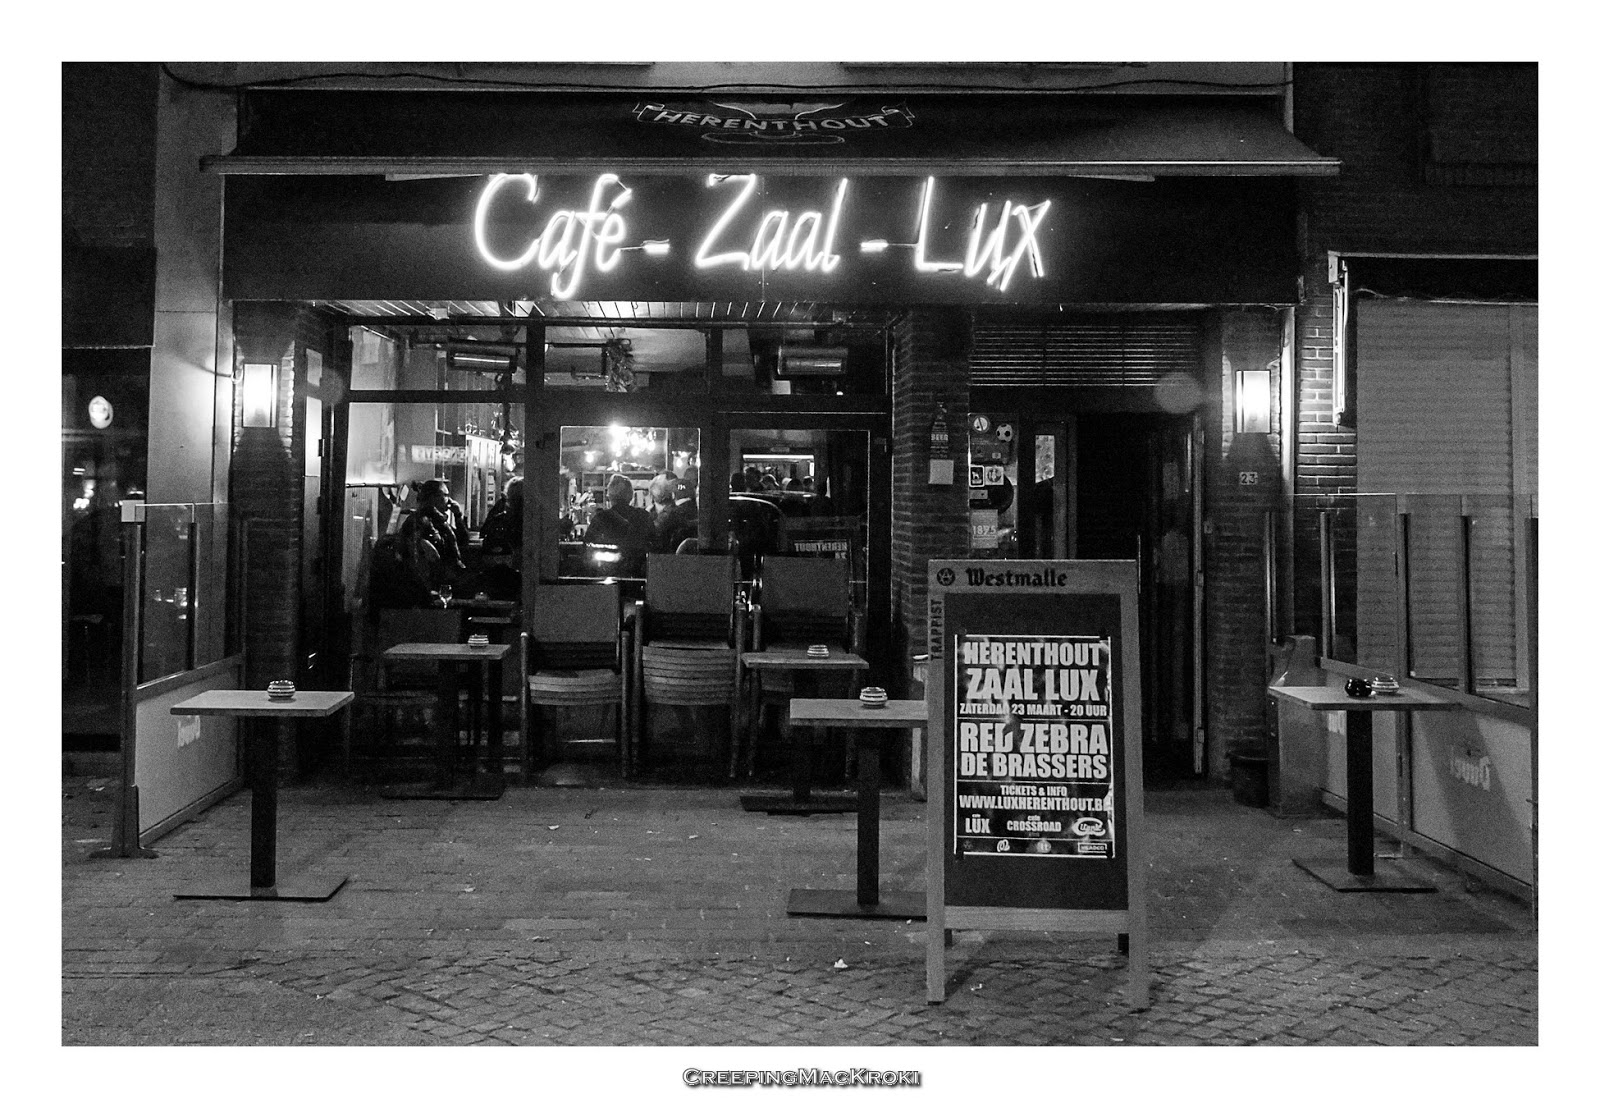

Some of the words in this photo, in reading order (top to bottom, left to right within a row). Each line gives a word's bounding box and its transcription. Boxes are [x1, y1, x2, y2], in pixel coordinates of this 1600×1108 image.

[653, 110, 889, 131] HERENTHOUT
[475, 173, 631, 298] Café
[696, 173, 848, 272] Zaal
[914, 176, 1051, 290] Lux
[1241, 473, 1256, 484] 23
[965, 567, 1068, 587] Westmalle
[930, 599, 943, 661] TRAPPIST
[963, 642, 1100, 666] HERENTHOUT
[966, 668, 1038, 700] ZAAL
[1045, 669, 1100, 701] LUX
[1011, 704, 1025, 715] 23
[1026, 704, 1063, 716] MAART
[1070, 704, 1084, 716] 20
[1085, 705, 1107, 717] UUR
[960, 722, 1014, 752] RED
[1020, 723, 1109, 754] ZEBRA
[961, 753, 988, 776] DE
[992, 753, 1108, 778] BRASSERS
[1000, 785, 1038, 796] TICKETS
[1047, 786, 1068, 797] INFO
[1006, 820, 1062, 832] CROSSROAD
